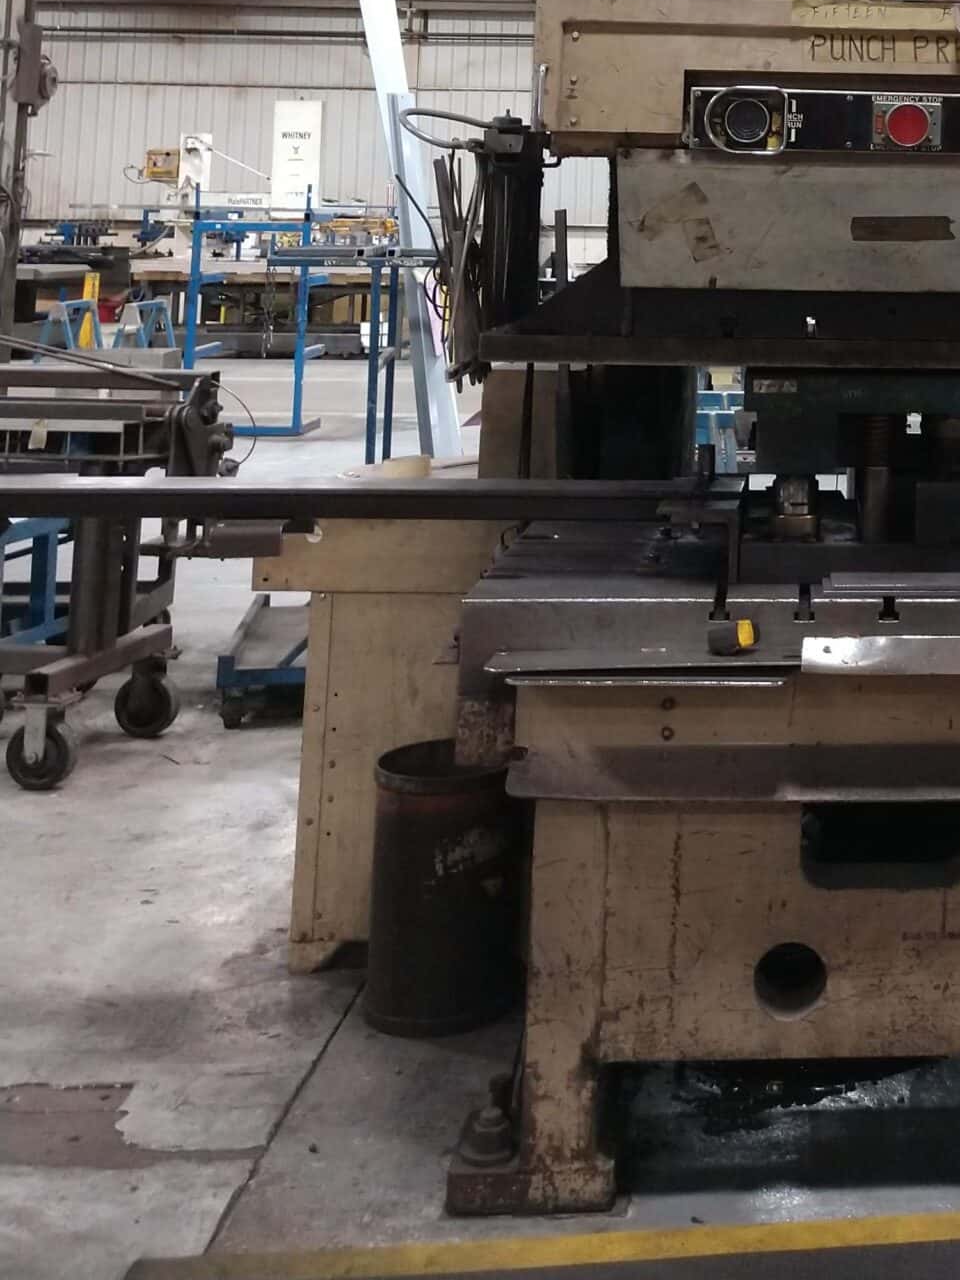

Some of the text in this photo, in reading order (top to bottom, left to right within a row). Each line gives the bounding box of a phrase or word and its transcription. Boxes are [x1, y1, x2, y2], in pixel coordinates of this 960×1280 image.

[810, 34, 896, 63] PUNCH
[871, 95, 943, 104] EMERGENCY STOP
[787, 113, 803, 121] NCH
[281, 131, 312, 140] WHITNEY
